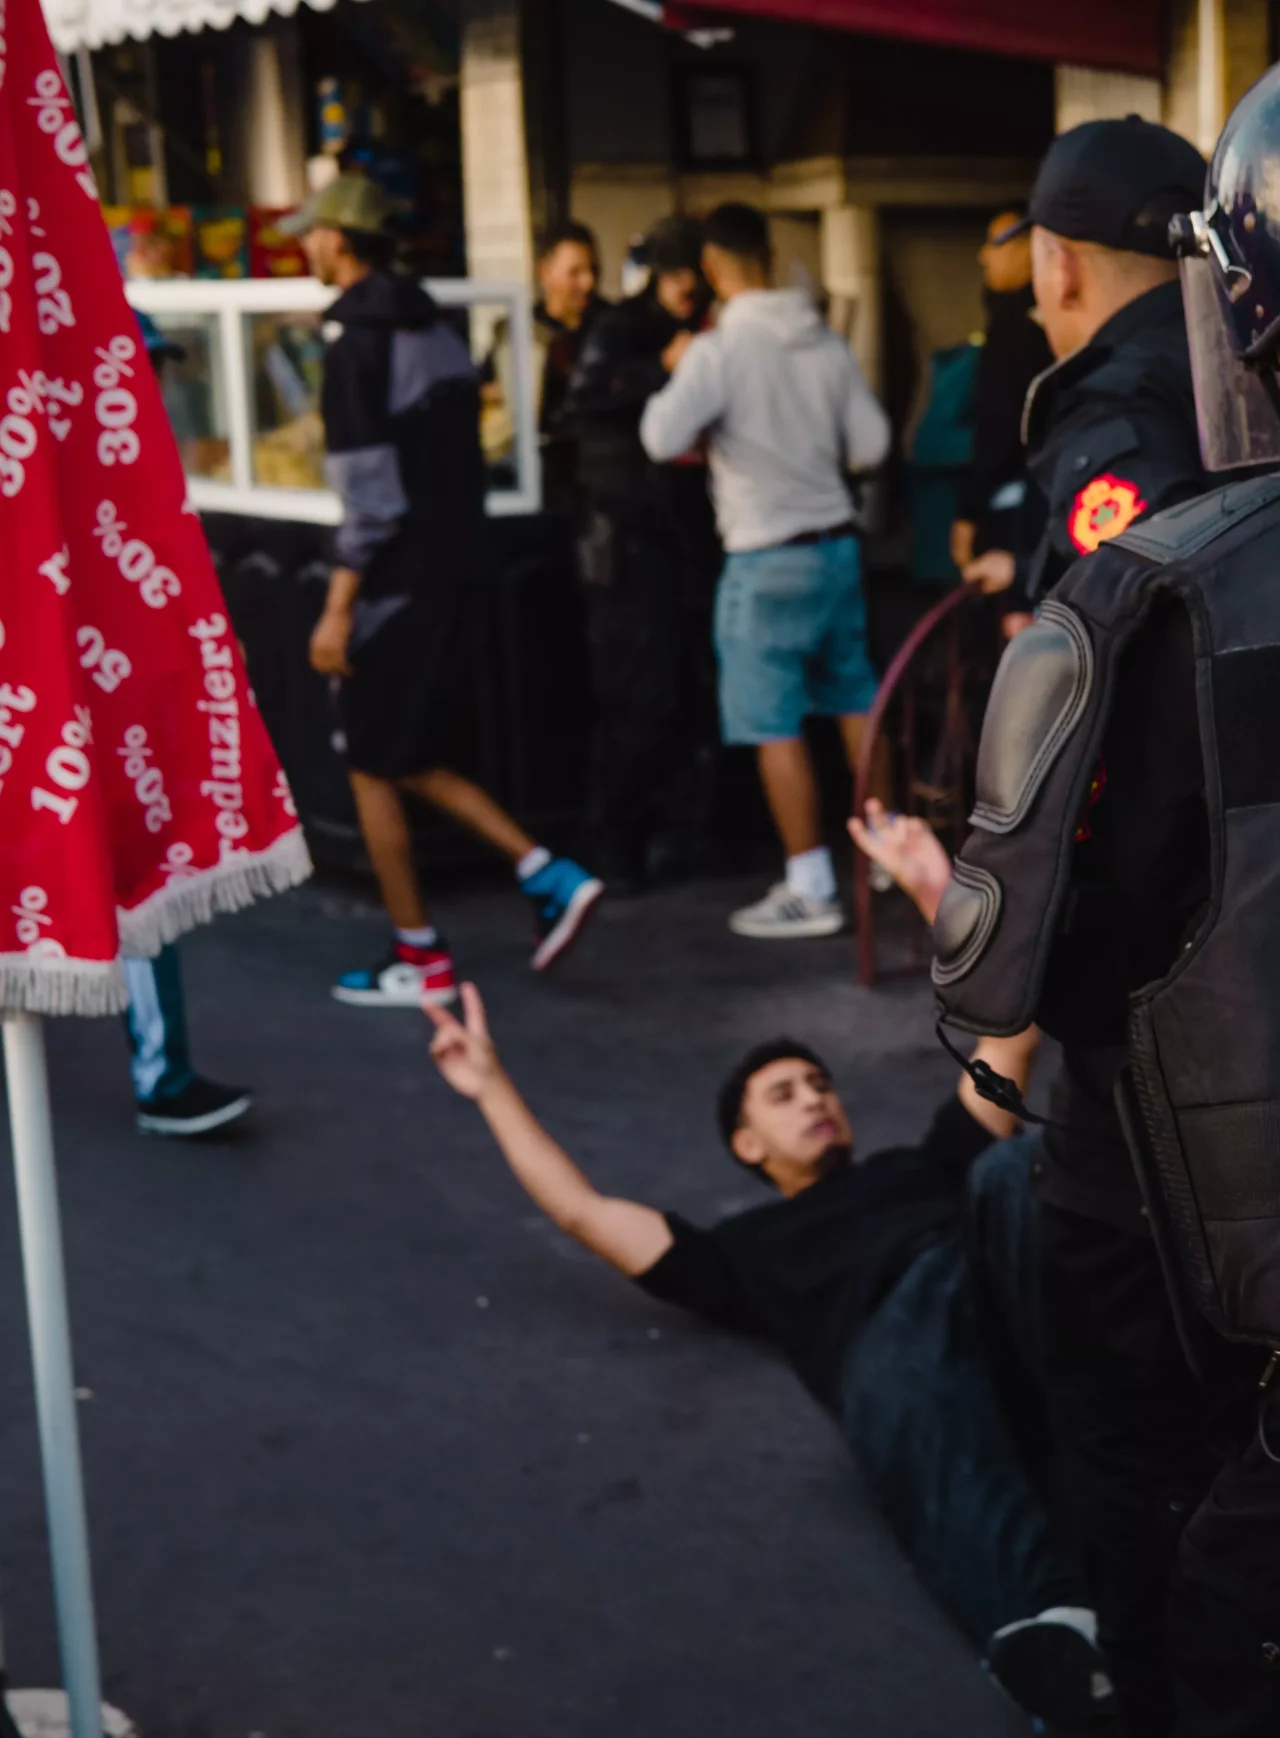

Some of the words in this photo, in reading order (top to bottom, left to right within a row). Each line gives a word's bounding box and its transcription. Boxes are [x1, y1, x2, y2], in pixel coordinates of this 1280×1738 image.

[26, 68, 99, 201] 0%
[0, 369, 50, 498] 30%
[94, 335, 140, 467] 30%
[92, 498, 183, 610] 30%
[116, 723, 173, 834] 20%
